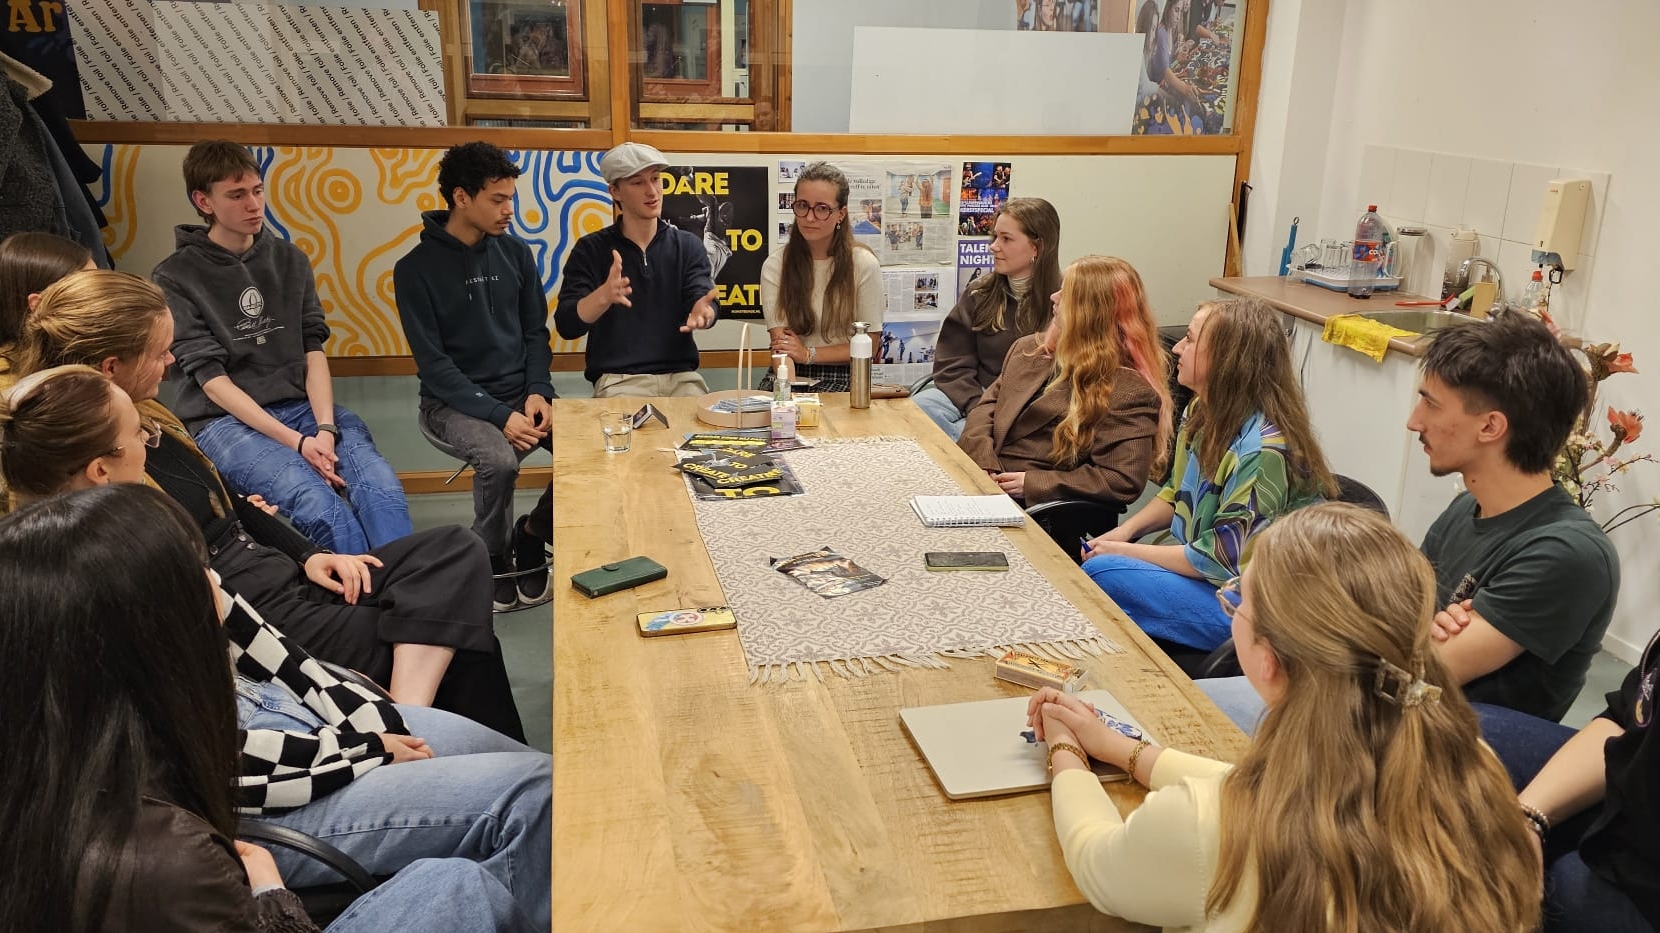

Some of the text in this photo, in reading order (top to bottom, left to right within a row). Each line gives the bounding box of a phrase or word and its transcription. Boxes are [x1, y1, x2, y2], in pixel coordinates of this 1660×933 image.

[82, 27, 100, 46] Folie
[91, 10, 122, 47] entfernen
[127, 28, 144, 48] Folie
[136, 11, 166, 48] entfernen
[180, 13, 209, 49] entfernen
[223, 14, 251, 51] entfernen
[266, 15, 294, 52] entfernen
[308, 17, 335, 56] entfernen
[350, 18, 376, 54] entfernen
[391, 20, 417, 56] entfernen
[171, 30, 187, 48] Folie
[214, 31, 230, 50] Folie
[257, 32, 272, 51] Folie
[299, 34, 314, 55] Folie
[340, 35, 356, 54] Folie
[382, 36, 397, 55] Folie
[422, 38, 437, 56] Folie
[75, 44, 93, 65] Folie
[99, 49, 113, 63] foil
[120, 47, 137, 66] Folie
[143, 51, 159, 64] foil
[163, 48, 180, 67] Folie
[186, 52, 200, 65] foil
[207, 49, 223, 68] Folie
[229, 53, 242, 66] foil
[249, 51, 265, 69] Folie
[272, 54, 284, 68] foil
[291, 51, 307, 71] Folie
[313, 55, 326, 69] foil
[333, 53, 348, 72] Folie
[354, 57, 367, 70] foil
[374, 54, 389, 73] Folie
[395, 58, 407, 71] foil
[415, 55, 429, 74] Folie
[92, 68, 106, 81] foil
[111, 62, 136, 93] Remove
[136, 69, 150, 82] foil
[154, 63, 179, 93] Remove
[179, 70, 192, 83] foil
[198, 65, 222, 94] Remove
[222, 71, 235, 84] foil
[240, 66, 263, 95] Remove
[264, 72, 277, 85] foil
[282, 67, 305, 97] Remove
[305, 73, 318, 87] foil
[323, 68, 346, 97] Remove
[346, 74, 360, 88] foil
[364, 69, 387, 99] Remove
[387, 76, 400, 89] foil
[427, 77, 440, 90] foil
[405, 70, 426, 99] Remove
[93, 95, 109, 112] folie
[104, 80, 129, 111] Remove
[137, 96, 153, 113] folie
[147, 81, 170, 111] Remove
[190, 82, 214, 112] Remove
[233, 83, 256, 113] Remove
[274, 84, 297, 114] Remove
[316, 85, 339, 115] Remove
[356, 86, 379, 116] Remove
[397, 88, 419, 117] Remove
[180, 97, 195, 114] folie
[223, 98, 237, 115] folie
[265, 99, 279, 115] folie
[306, 99, 320, 116] folie
[346, 100, 360, 117] folie
[387, 102, 400, 118] folie
[427, 102, 440, 119] folie
[660, 172, 730, 195] DARE
[726, 229, 763, 252] TO
[729, 461, 747, 469] TO
